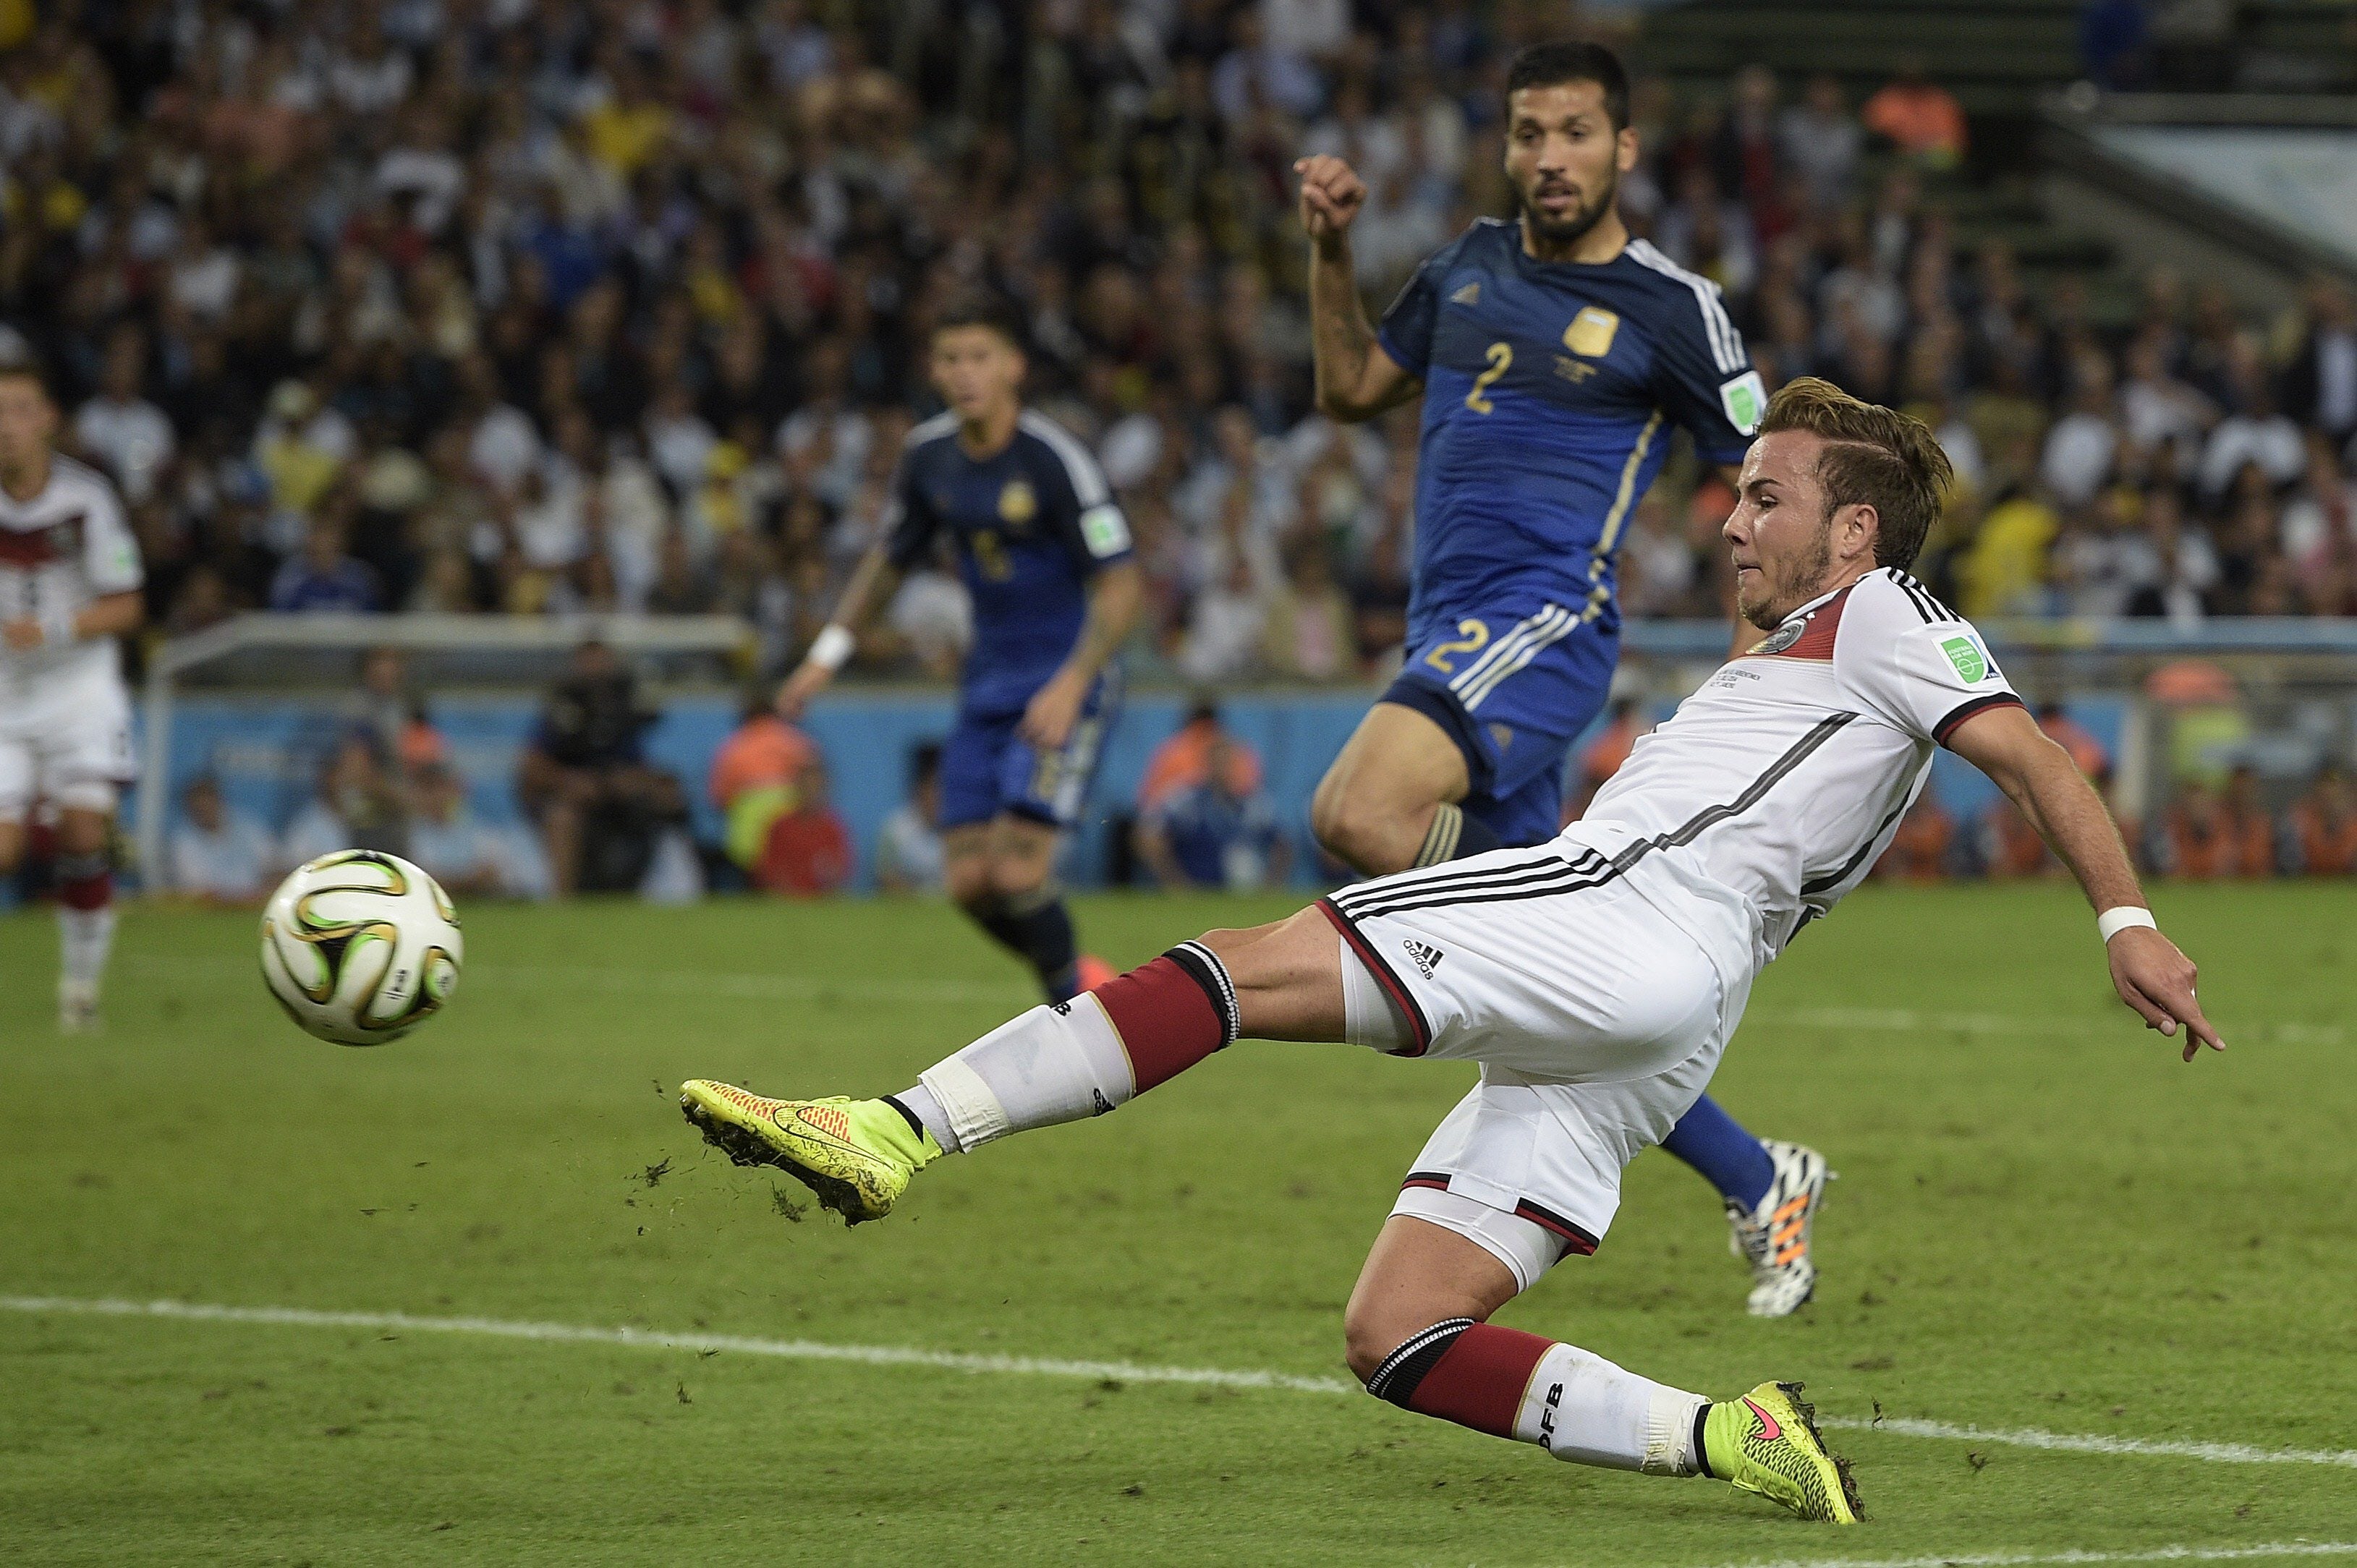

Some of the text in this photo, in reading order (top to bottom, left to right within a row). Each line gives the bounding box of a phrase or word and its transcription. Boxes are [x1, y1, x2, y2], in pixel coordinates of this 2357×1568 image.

[1466, 342, 1513, 414] 2
[1426, 619, 1489, 673] 2
[1403, 939, 1434, 980] adidas
[1538, 1382, 1563, 1453] DFB
